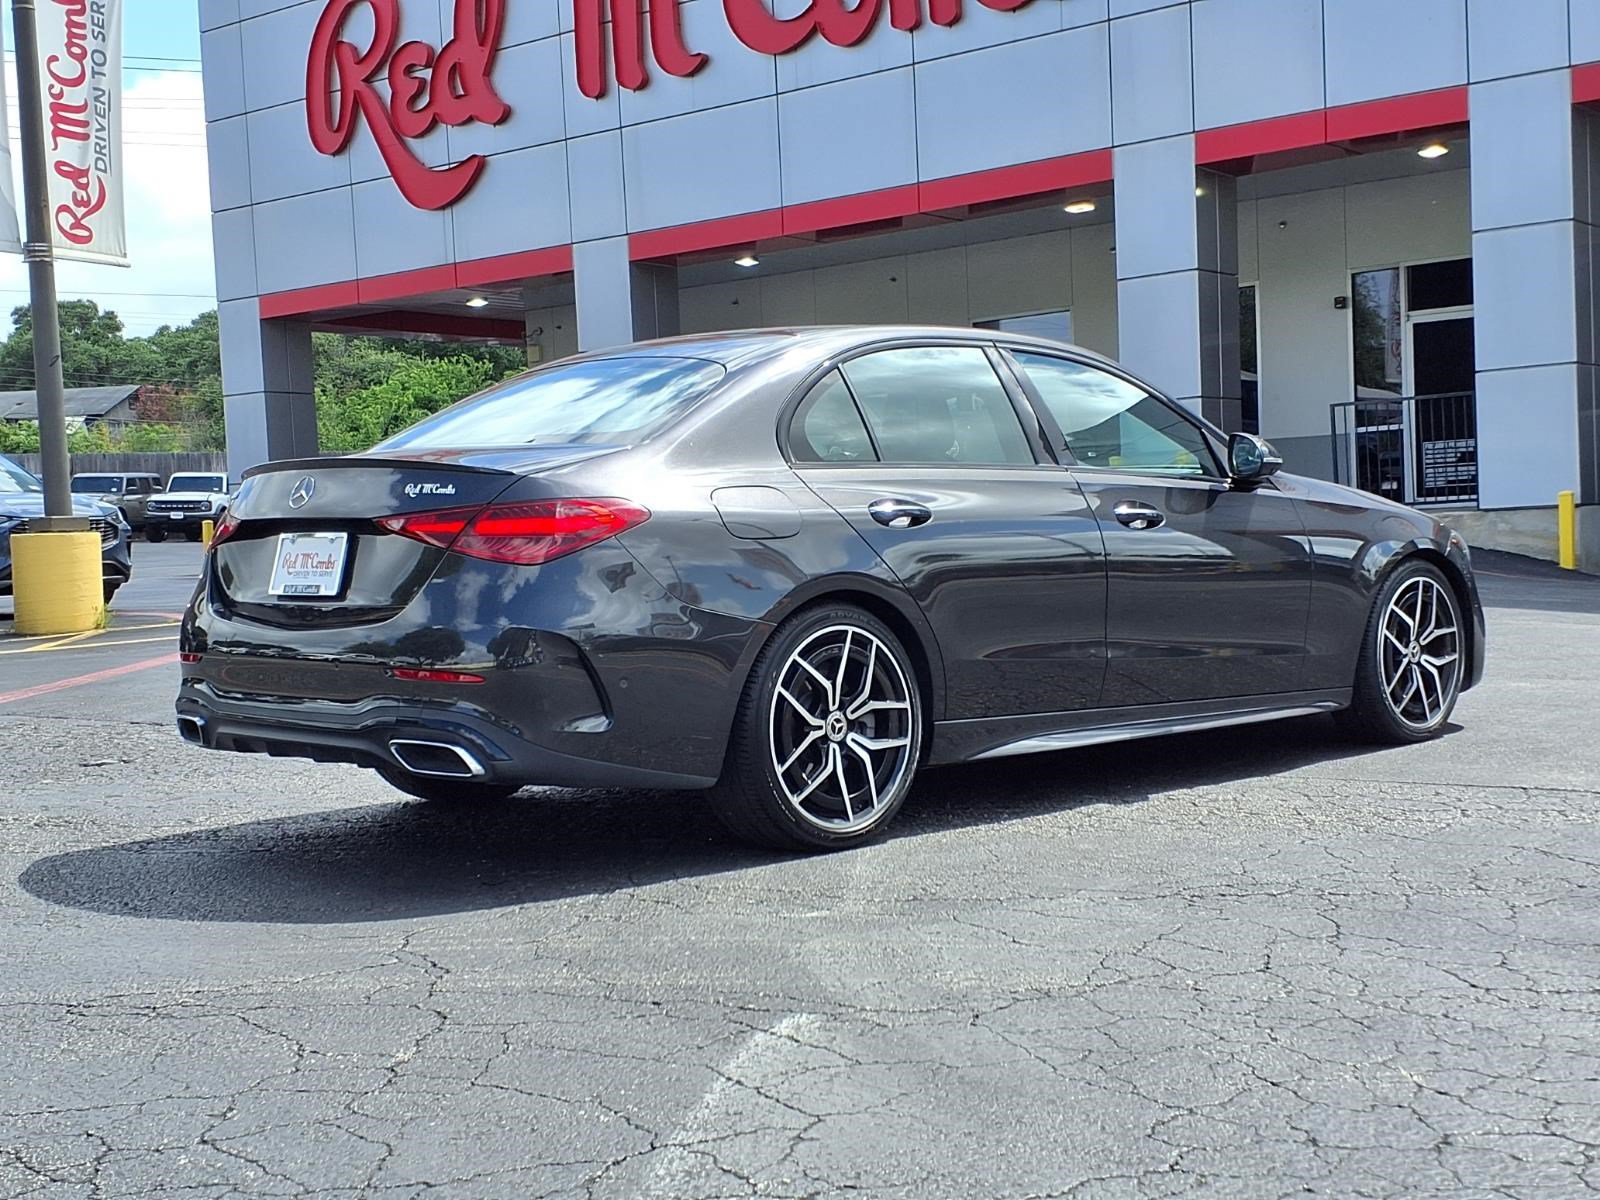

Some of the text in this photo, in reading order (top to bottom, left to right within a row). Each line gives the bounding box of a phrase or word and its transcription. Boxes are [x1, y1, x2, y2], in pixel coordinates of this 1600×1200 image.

[91, 49, 107, 79] TO
[93, 87, 108, 174] DRIVEN
[306, 0, 512, 211] Red
[54, 160, 107, 245] Red
[404, 483, 421, 498] Red
[282, 552, 338, 576] Red McCombs
